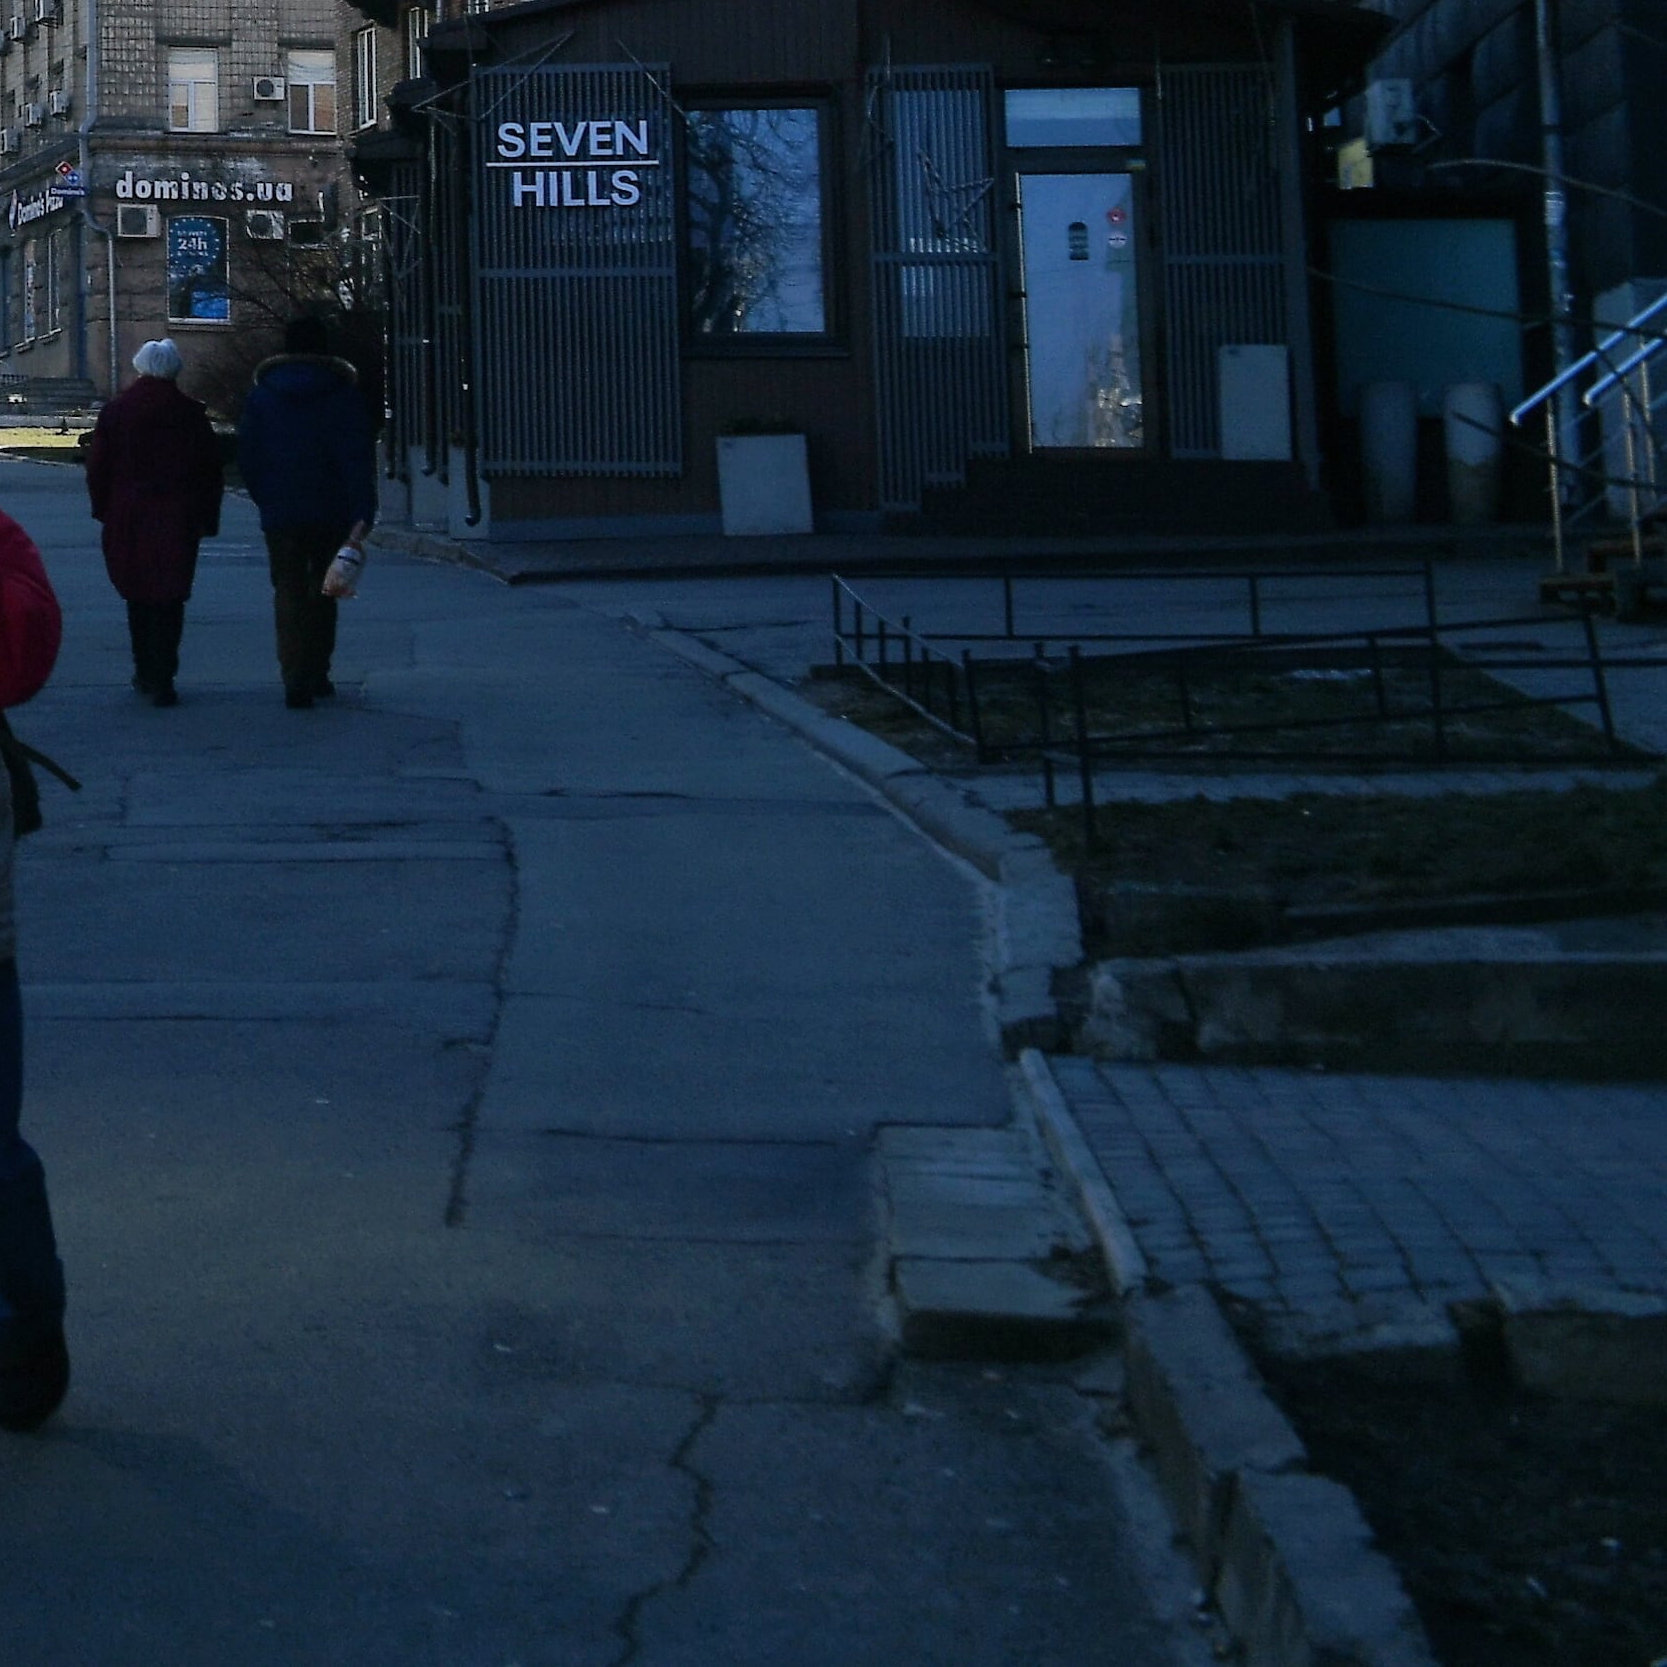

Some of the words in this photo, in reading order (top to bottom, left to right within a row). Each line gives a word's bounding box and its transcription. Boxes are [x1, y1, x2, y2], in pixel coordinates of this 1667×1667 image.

[497, 120, 649, 158] SEVEN
[116, 170, 294, 202] dominos.ua
[513, 169, 641, 207] HILLS
[177, 236, 208, 251] 24h
